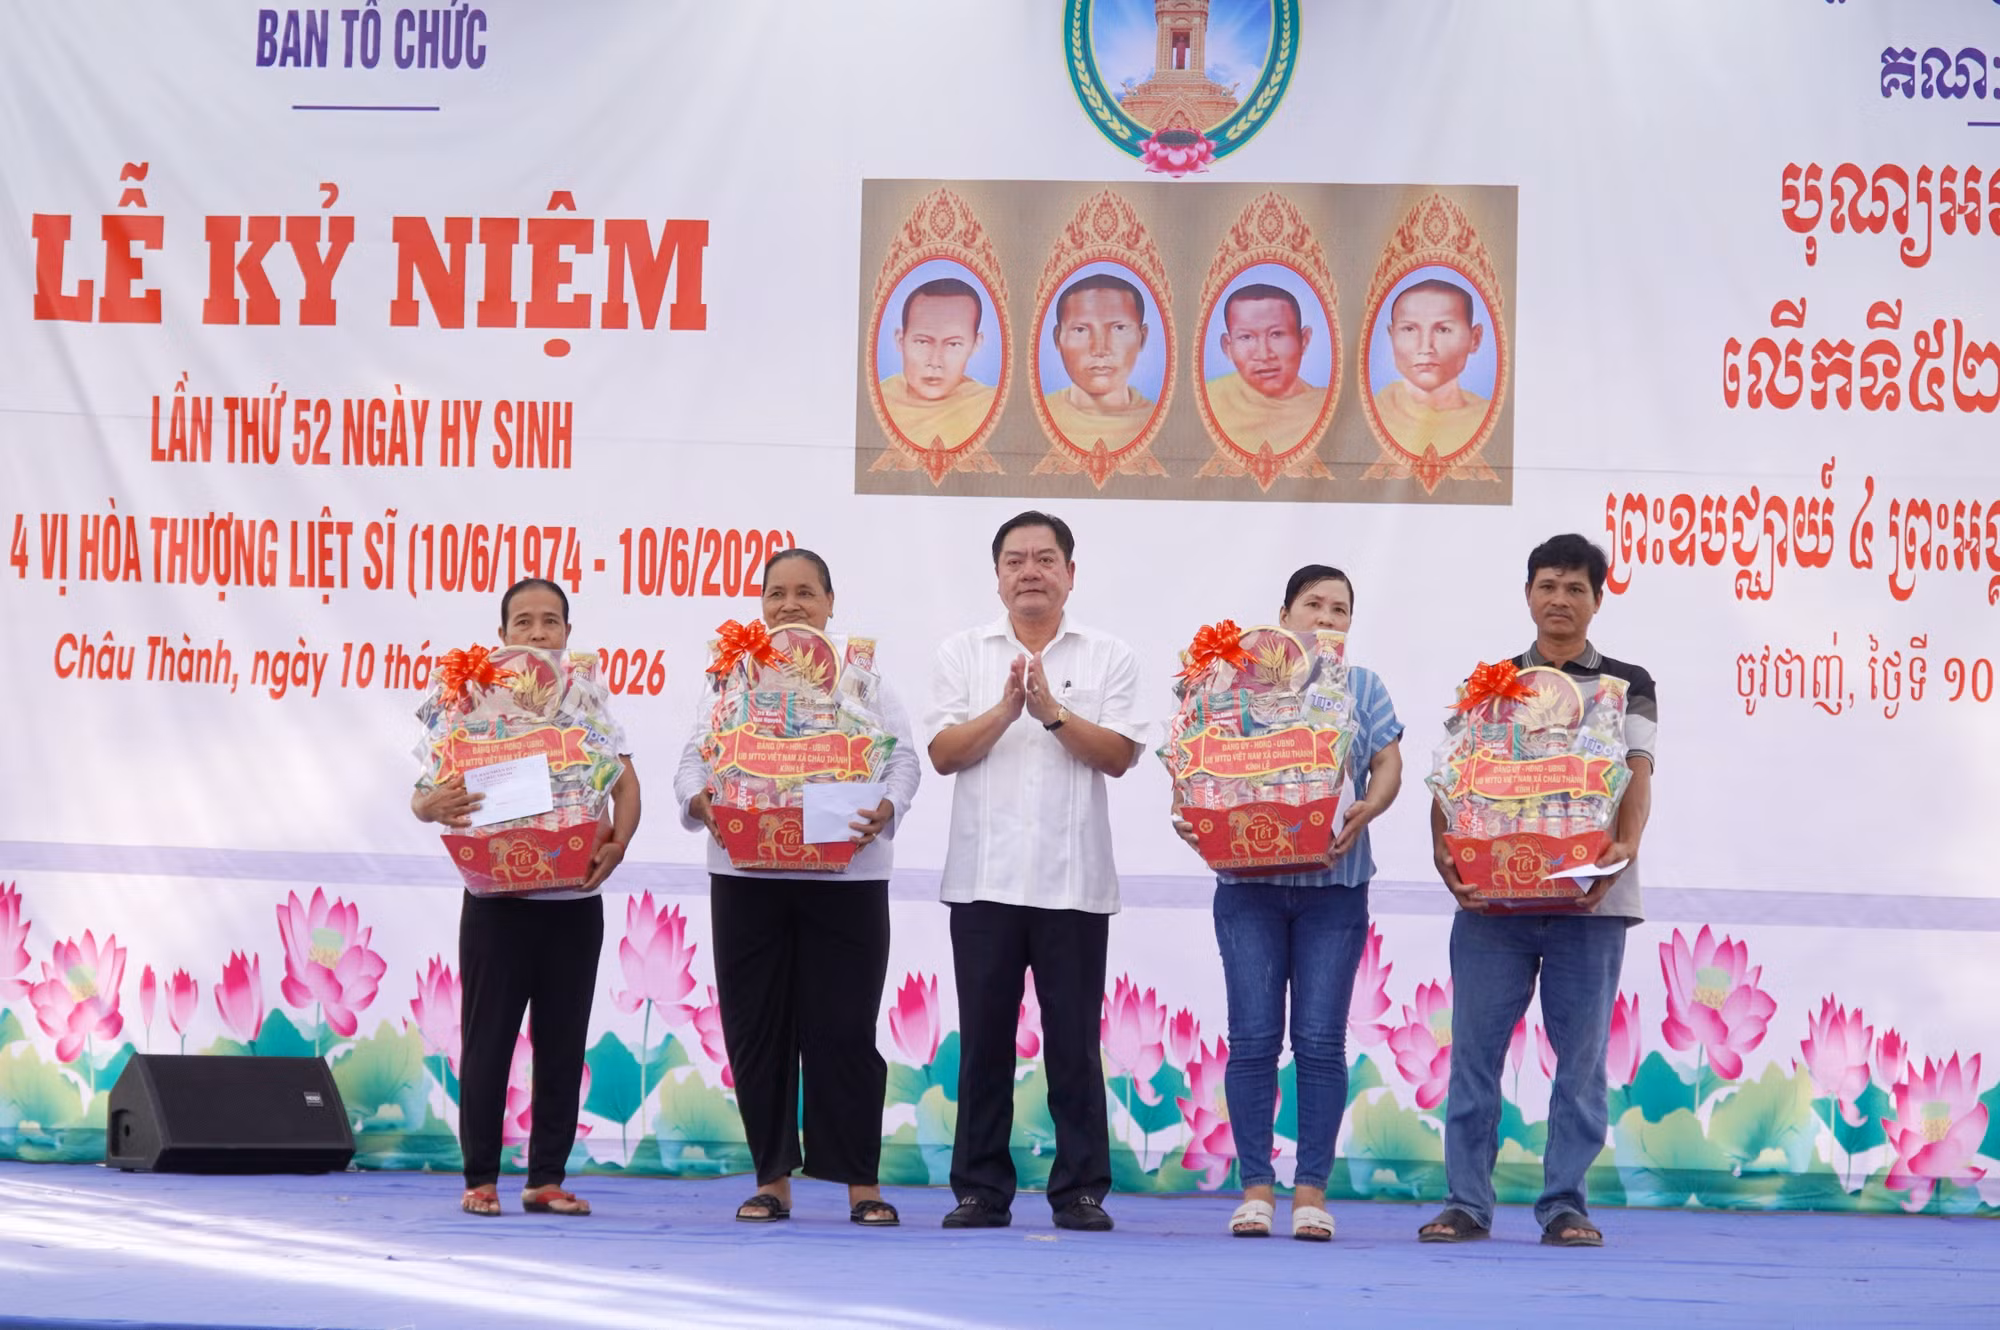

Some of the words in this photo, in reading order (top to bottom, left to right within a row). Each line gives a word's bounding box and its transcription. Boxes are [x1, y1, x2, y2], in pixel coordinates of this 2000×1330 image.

[256, 9, 329, 67] BAN
[394, 0, 487, 69] CHỨC
[32, 162, 165, 324] LỄ
[202, 182, 355, 327] KỶ
[390, 190, 709, 358] NIỆM
[151, 371, 213, 463] LẦN
[224, 383, 286, 465] THỨ
[292, 399, 331, 465] 52
[341, 384, 429, 467] NGÀY
[440, 400, 483, 468] HY
[492, 400, 573, 469] SINH
[10, 513, 29, 579] 4
[40, 513, 69, 596] VỊ
[79, 497, 142, 582] HÒA
[150, 512, 278, 602] THƯỢNG
[289, 506, 353, 604] LIỆT
[363, 507, 398, 591] SĨ
[407, 523, 582, 599] (10/6/1974
[594, 558, 605, 573] -
[619, 526, 796, 598] 10/6/202
[53, 630, 135, 680] Châu
[147, 632, 238, 693] Thành,
[251, 636, 329, 700] ngày
[341, 641, 375, 688] 10
[384, 639, 441, 691] thá
[1943, 657, 1994, 703] ១០
[1312, 692, 1344, 712] Tipo
[782, 754, 797, 762] NAM
